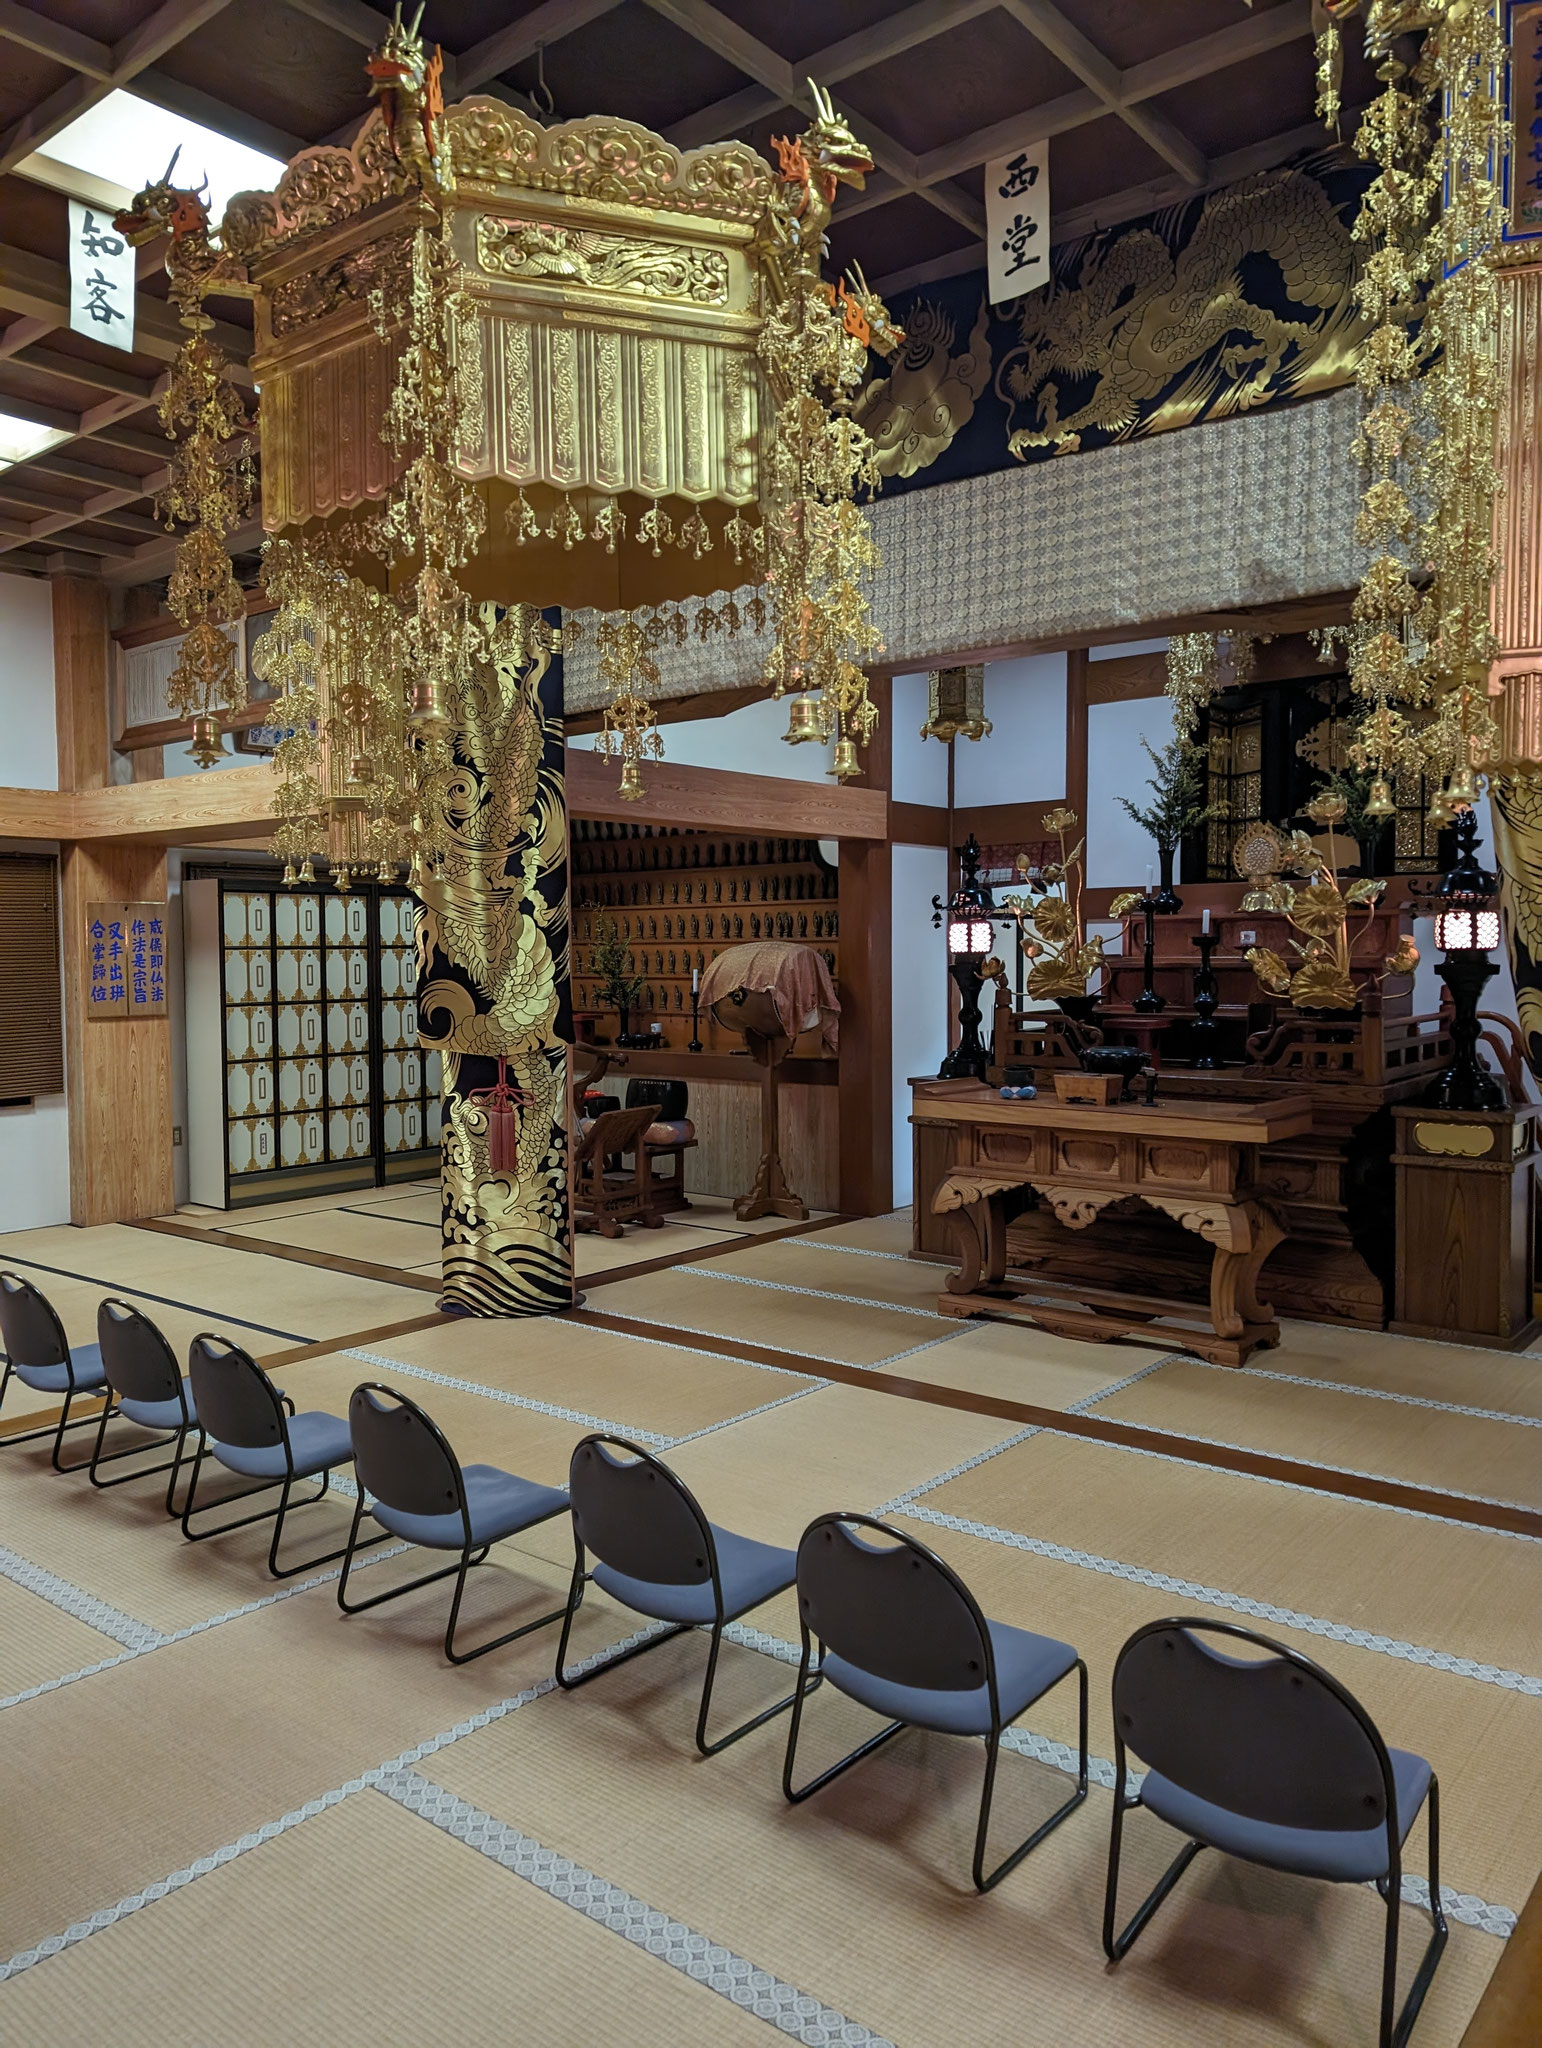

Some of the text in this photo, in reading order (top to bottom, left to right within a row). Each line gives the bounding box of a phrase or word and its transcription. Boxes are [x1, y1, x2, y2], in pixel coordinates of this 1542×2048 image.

[999, 153, 1041, 277] 西堂
[81, 210, 125, 325] 知客
[108, 921, 125, 1002] 叉手出班
[131, 919, 147, 1003] 作法是宗旨
[149, 918, 164, 1002] 威儀即仏法
